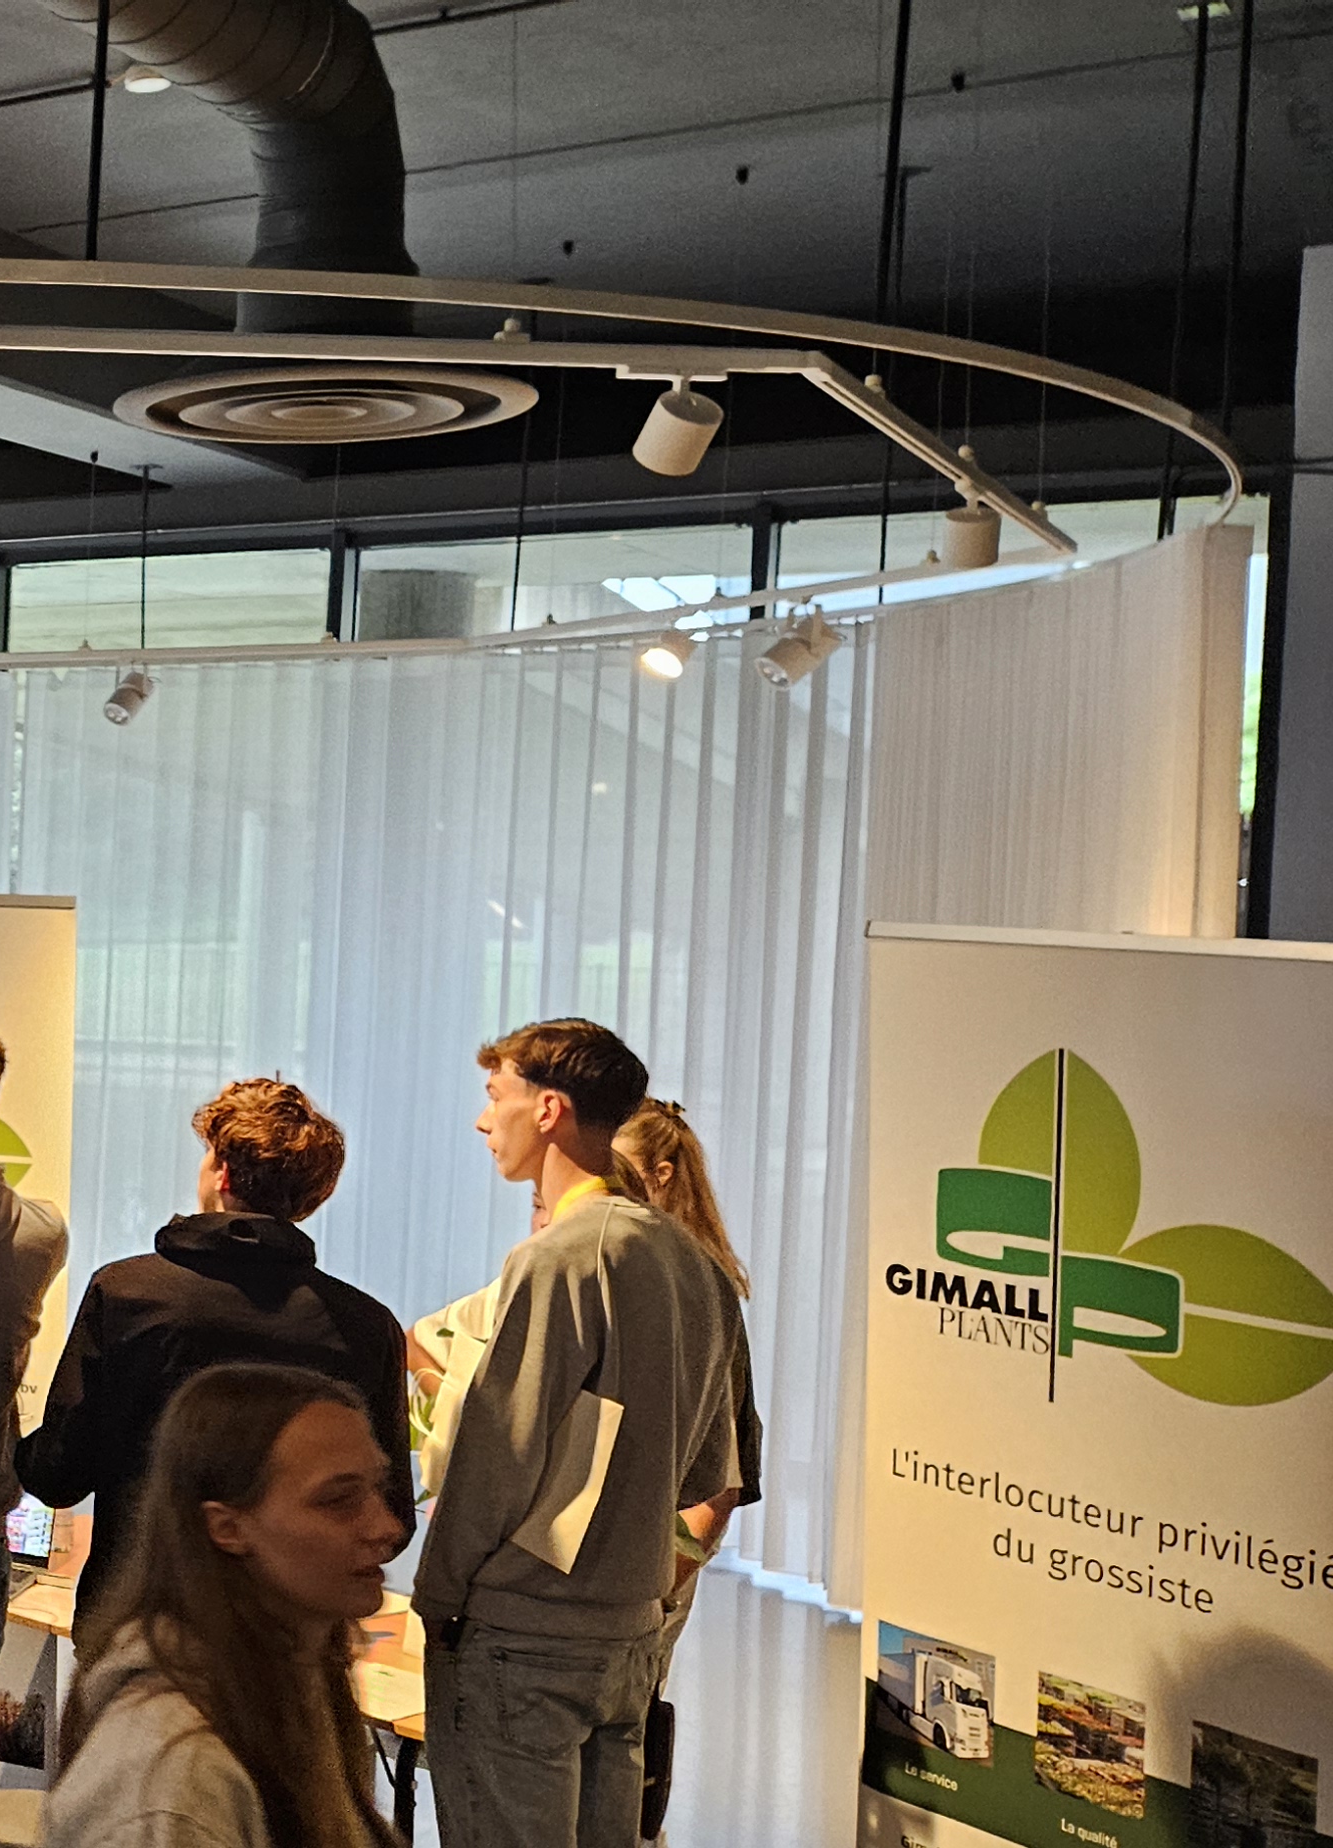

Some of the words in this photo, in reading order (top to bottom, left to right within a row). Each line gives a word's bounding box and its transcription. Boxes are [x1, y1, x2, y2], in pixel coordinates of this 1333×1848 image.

[886, 1263, 1049, 1323] GIMALL
[938, 1306, 1050, 1354] PLANTS
[891, 1447, 1144, 1538] L'interlocuteur
[992, 1527, 1035, 1565] du
[1048, 1547, 1214, 1614] grossiste
[905, 1761, 918, 1777] Le
[920, 1769, 959, 1792] service
[1061, 1817, 1075, 1834] La
[1077, 1826, 1118, 1848] qualité
